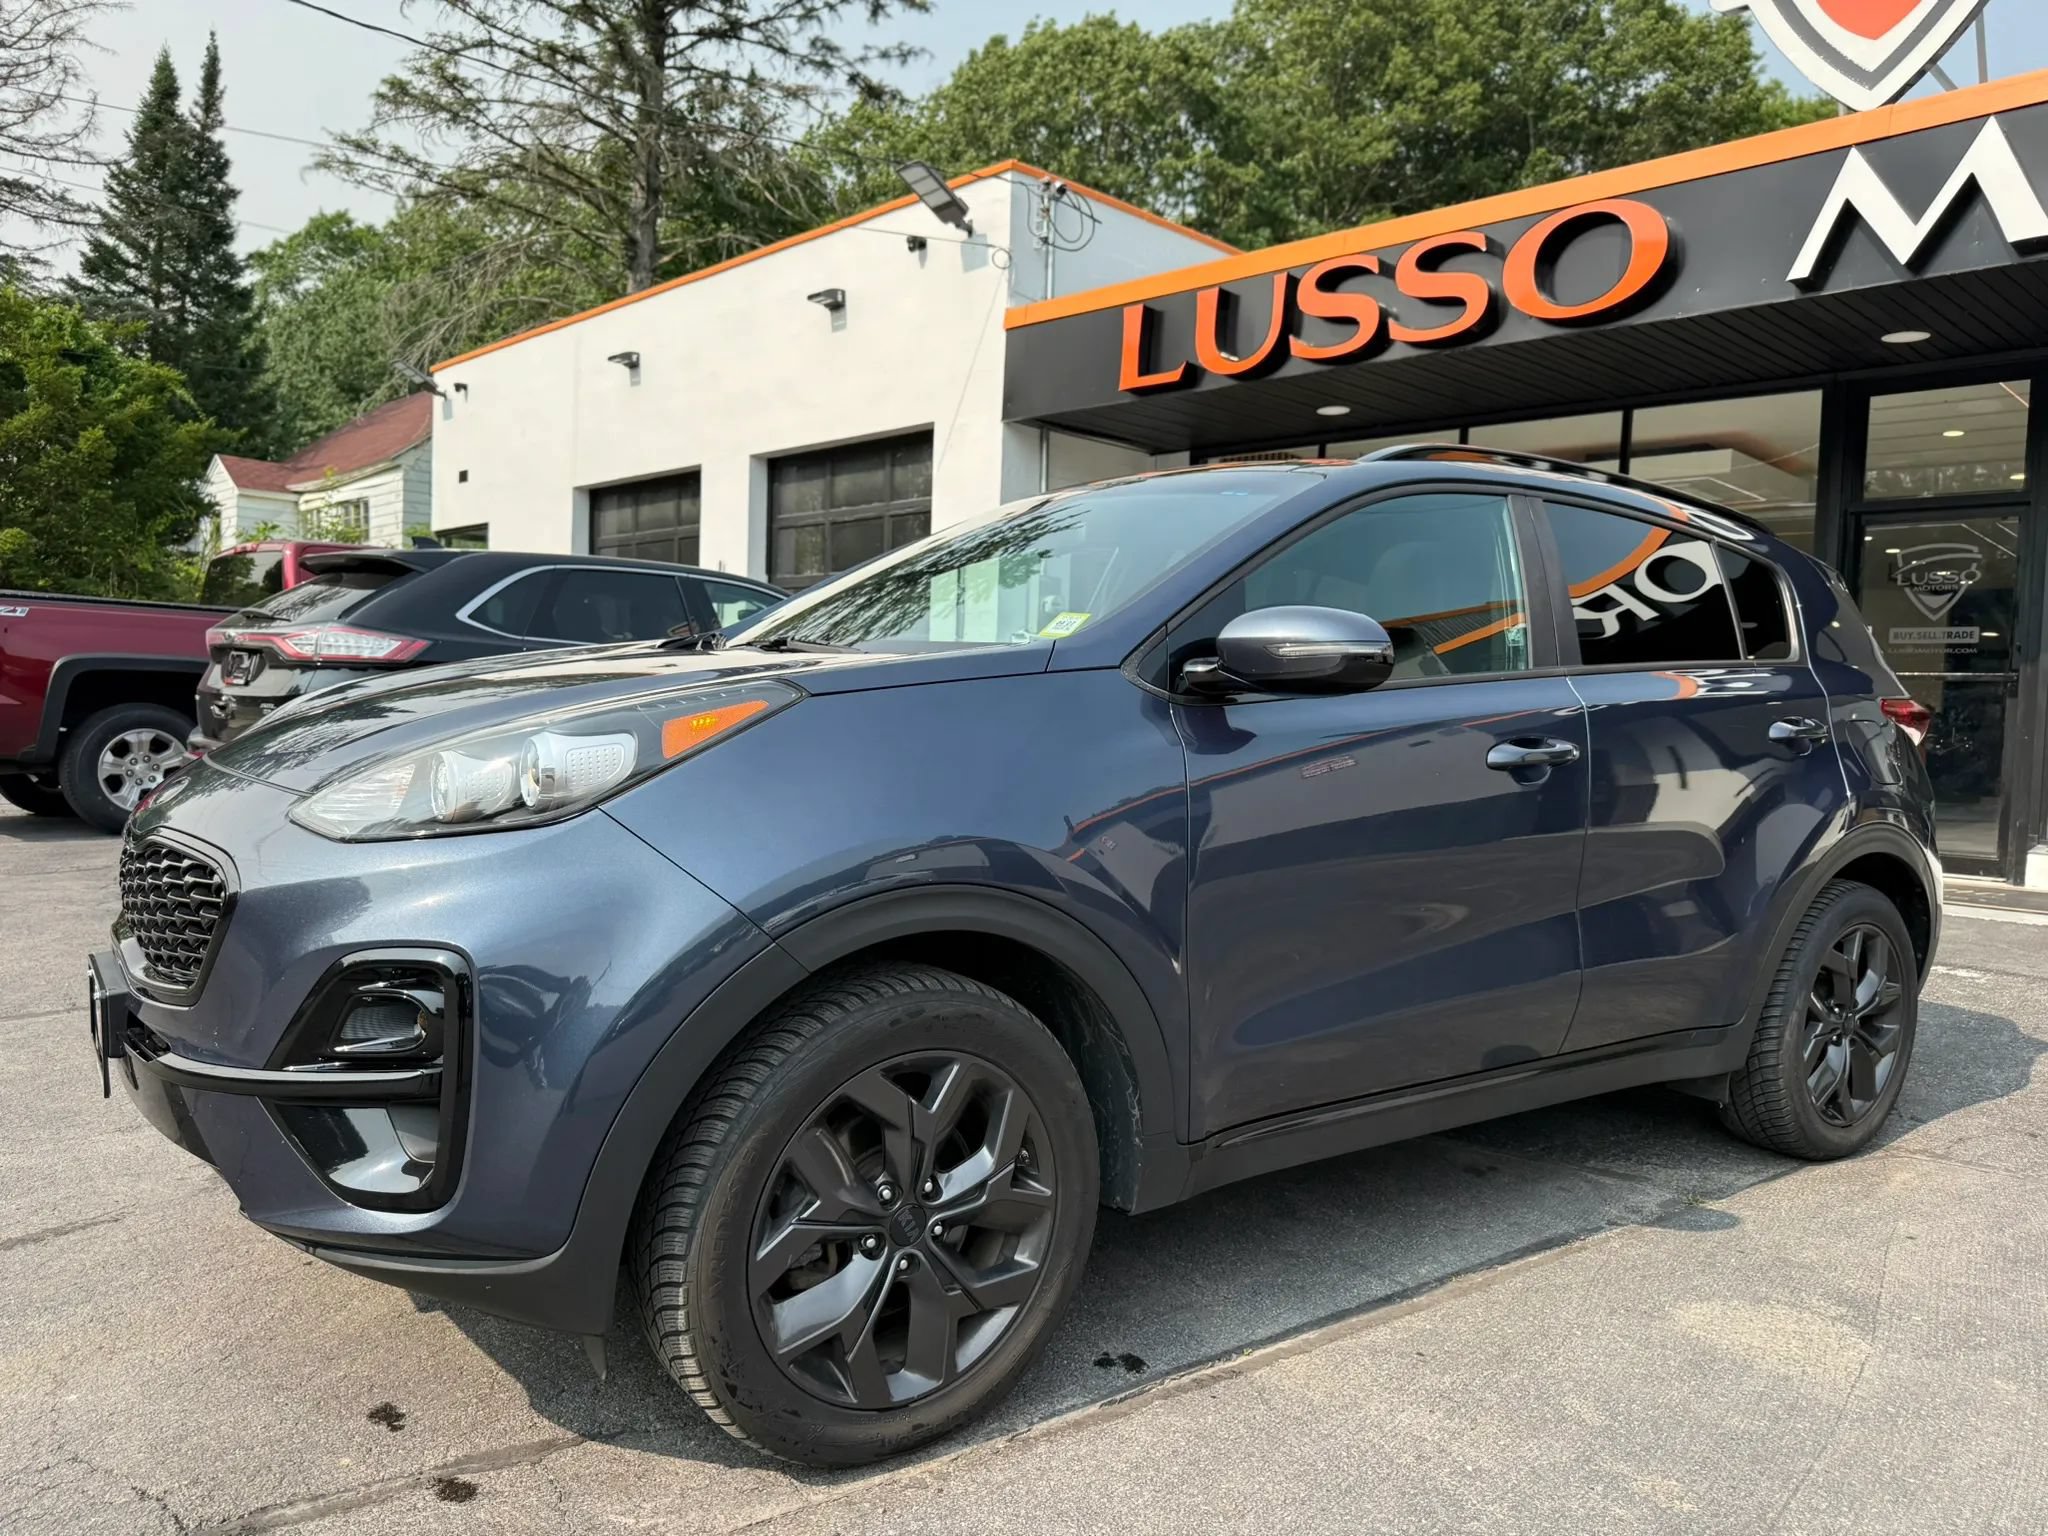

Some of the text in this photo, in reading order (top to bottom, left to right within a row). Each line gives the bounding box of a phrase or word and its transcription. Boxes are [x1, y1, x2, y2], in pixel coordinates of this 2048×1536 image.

[1118, 116, 2048, 393] LUSSO M
[1896, 570, 1982, 586] LUSSO
[1912, 583, 1959, 592] MOTORS
